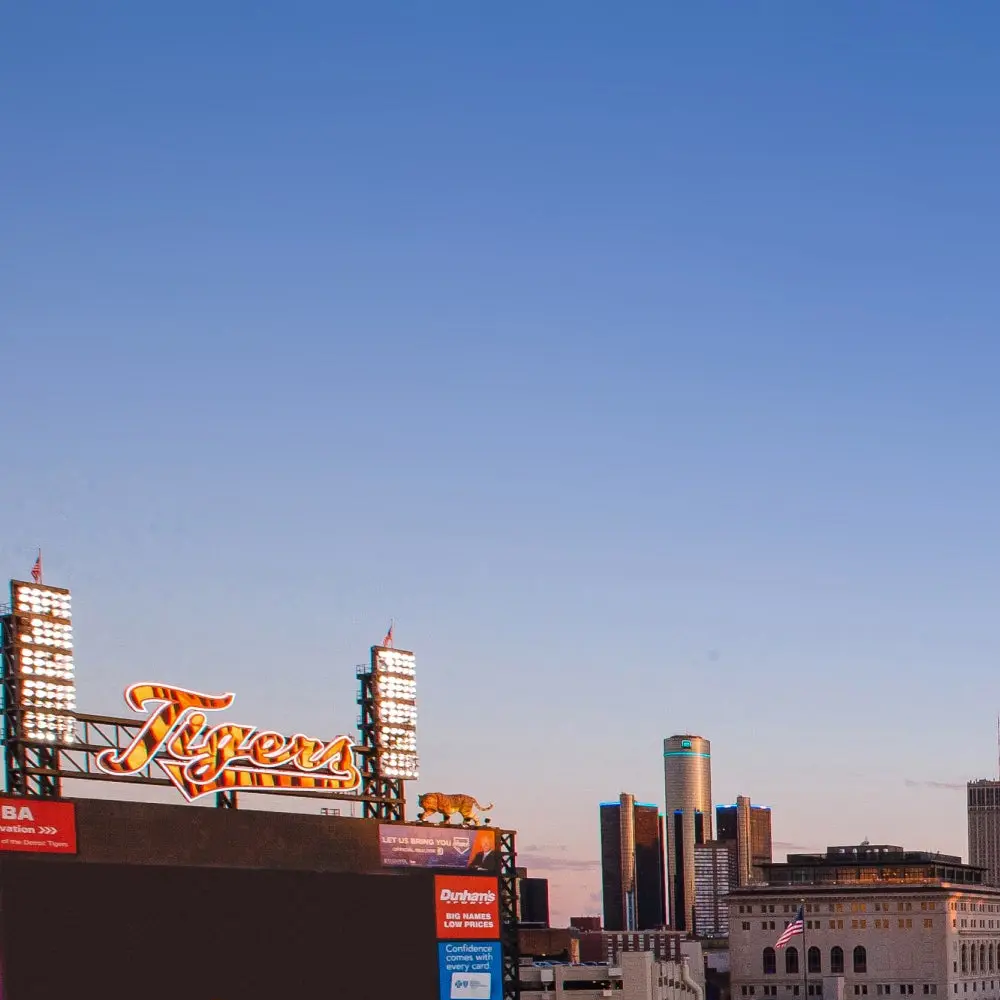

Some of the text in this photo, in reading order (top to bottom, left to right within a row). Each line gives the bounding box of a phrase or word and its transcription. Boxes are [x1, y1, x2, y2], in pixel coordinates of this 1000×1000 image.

[95, 682, 362, 803] Tigers
[48, 840, 69, 848] Tigers
[382, 836, 397, 844] LET
[411, 838, 435, 846] BRING
[437, 839, 452, 847] YOU
[440, 889, 496, 902] Dunham's
[445, 944, 493, 953] Confidence
[475, 953, 493, 961] with
[446, 963, 470, 972] every
